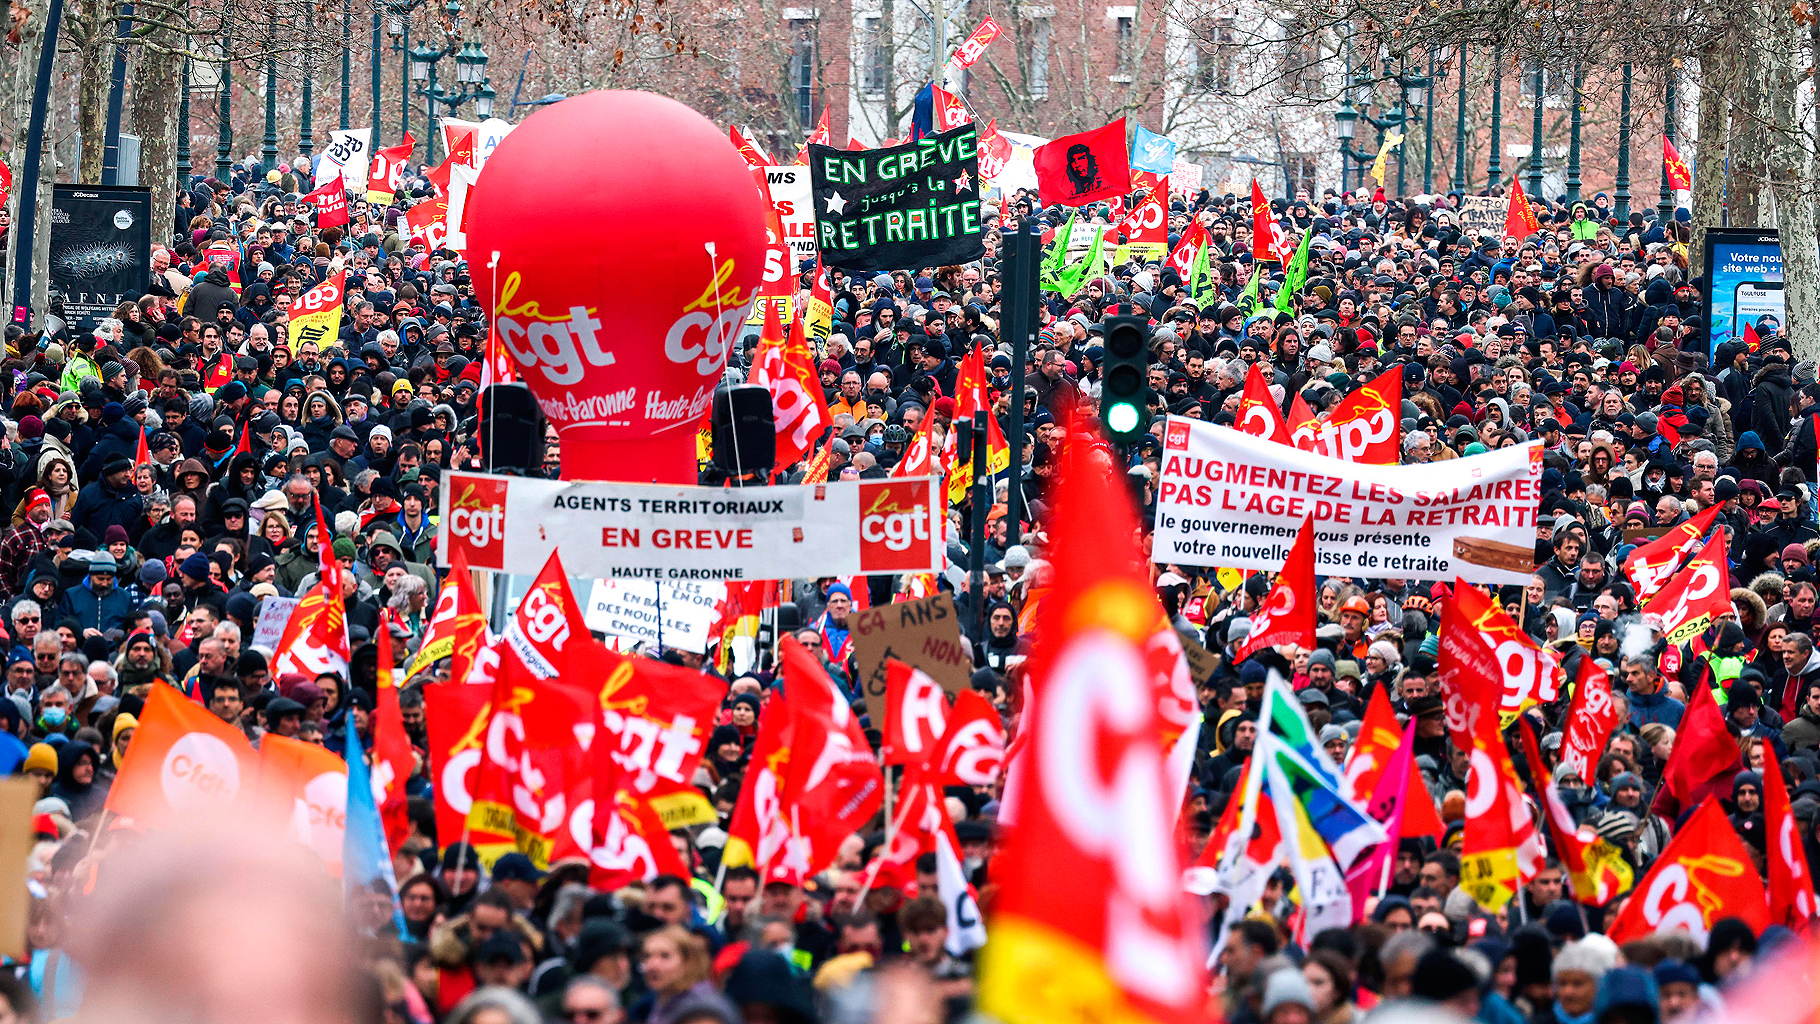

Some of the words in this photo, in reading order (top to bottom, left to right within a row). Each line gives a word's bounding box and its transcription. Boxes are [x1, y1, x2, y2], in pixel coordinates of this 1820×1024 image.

[824, 156, 867, 184] EN
[926, 175, 946, 192] la
[1722, 262, 1743, 273] site
[1744, 263, 1768, 273] web
[1730, 252, 1760, 263] Votre
[497, 305, 616, 386] cgt
[1168, 430, 1186, 445] cgt
[1164, 455, 1344, 497] AUGMENTEZ
[1351, 479, 1404, 505] LES
[1413, 478, 1542, 508] SALAIRES
[1528, 461, 1545, 476] cg
[554, 495, 632, 513] AGENTS
[639, 499, 784, 515] TERRITORIAUX
[1160, 482, 1212, 507] PAS
[1221, 488, 1305, 519] L'AGE
[1313, 500, 1352, 524] DE
[1361, 505, 1397, 526] LA
[450, 504, 504, 548] cgt
[601, 527, 640, 549] EN
[652, 528, 754, 550] GREVE
[862, 504, 929, 551] cgt
[1160, 512, 1176, 529] le
[1353, 531, 1431, 548] présente
[1173, 538, 1217, 556] votre
[1221, 544, 1291, 562] nouvelle
[1315, 547, 1352, 566] isse
[1357, 550, 1379, 568] de
[1384, 554, 1450, 572] retraite
[611, 567, 664, 579] HAUTE
[668, 567, 744, 580] GARONNE
[597, 601, 621, 616] DES
[622, 592, 642, 603] EN
[643, 597, 668, 611] BAS
[671, 591, 690, 603] EN
[693, 595, 714, 609] OR
[900, 595, 948, 629] ANS
[921, 635, 965, 667] NON
[1478, 631, 1559, 708] gt
[604, 710, 701, 793] gt
[309, 803, 347, 831] Cf
